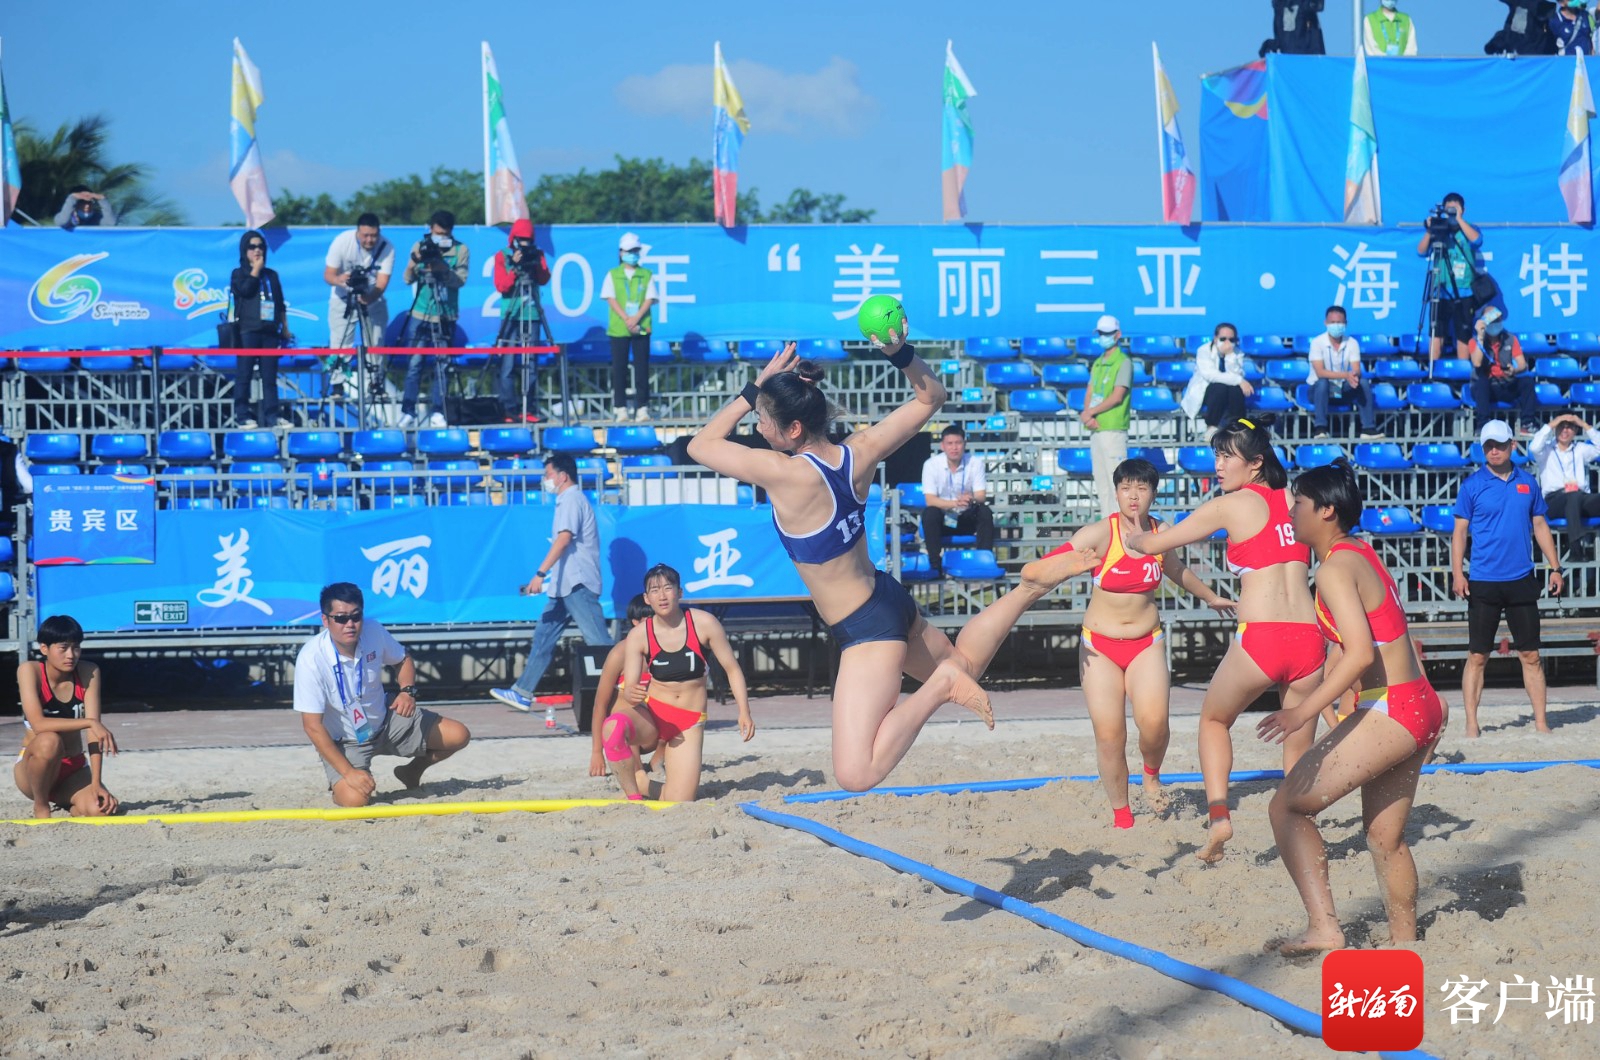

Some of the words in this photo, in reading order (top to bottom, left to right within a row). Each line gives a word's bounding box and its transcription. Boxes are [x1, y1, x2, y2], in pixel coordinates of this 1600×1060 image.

[49, 508, 139, 533] 贵宾区
[836, 509, 862, 544] 13
[1274, 522, 1296, 547] 19
[1142, 561, 1161, 583] 20
[163, 612, 185, 620] EXIT
[352, 708, 365, 725] A
